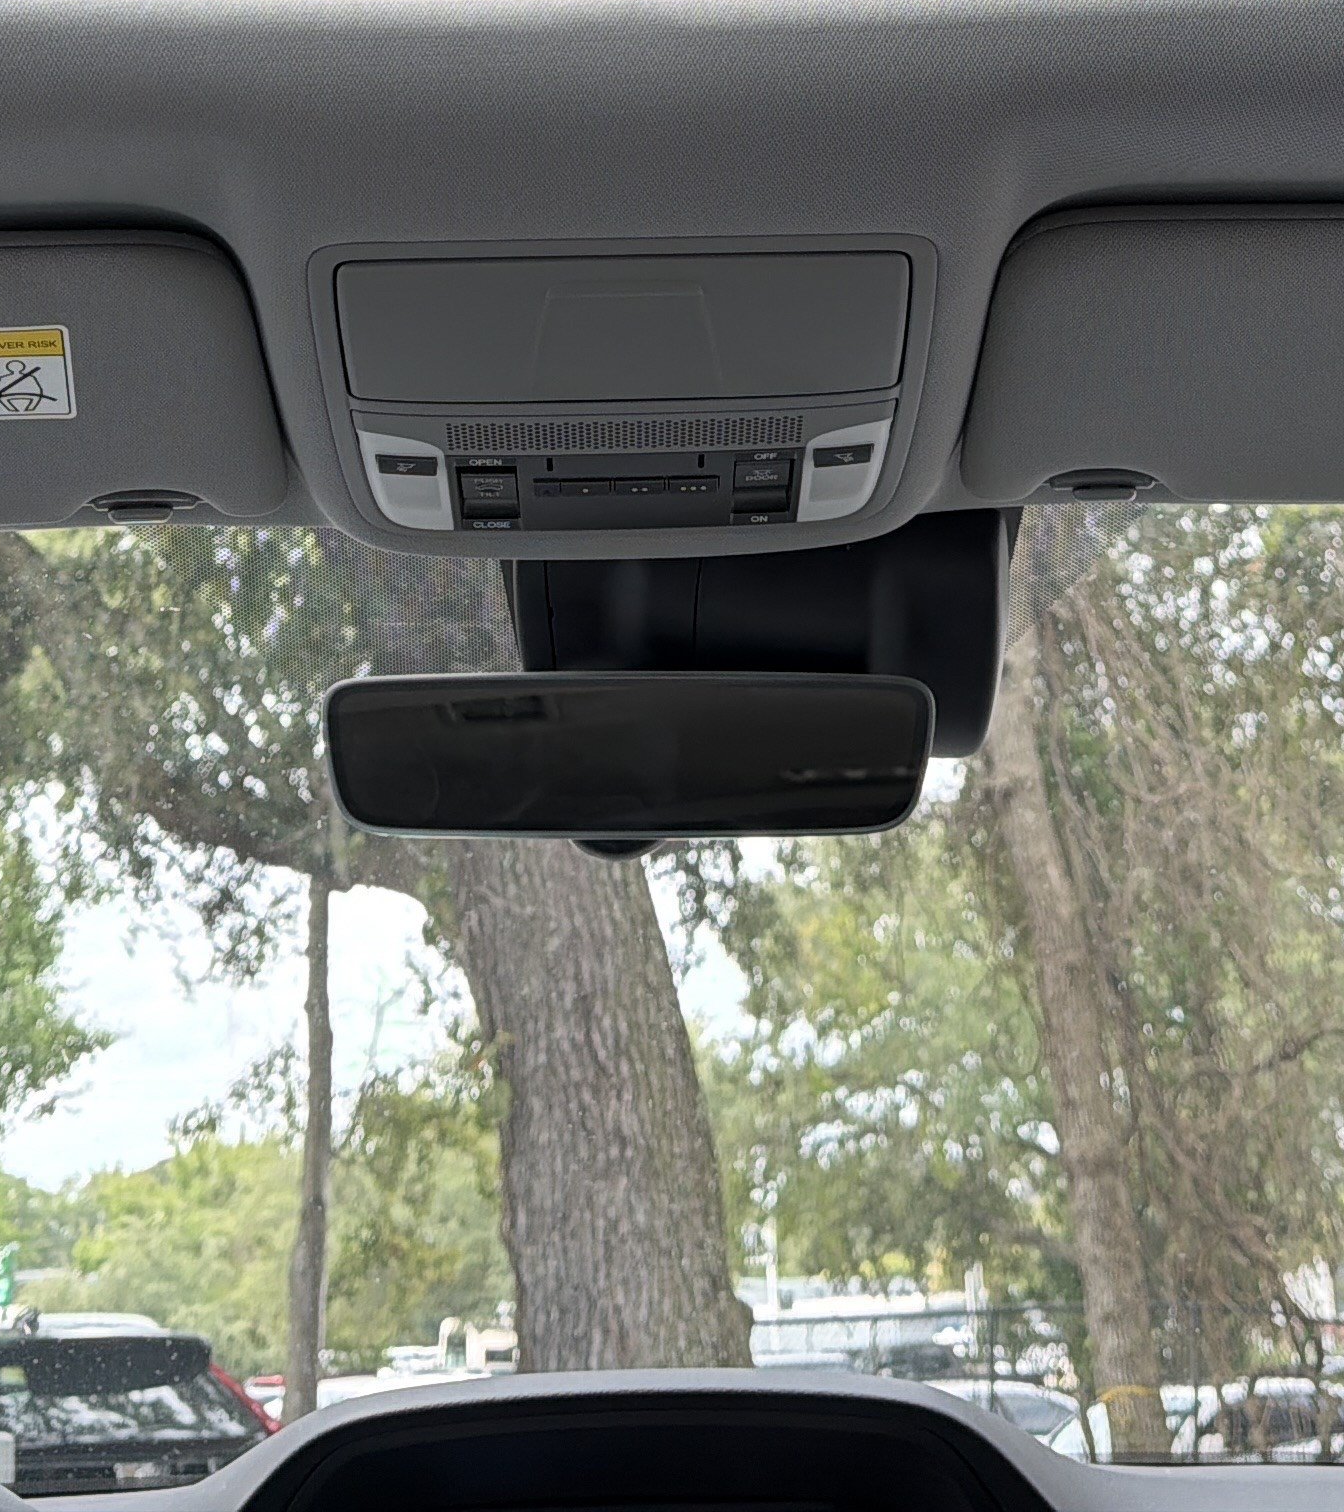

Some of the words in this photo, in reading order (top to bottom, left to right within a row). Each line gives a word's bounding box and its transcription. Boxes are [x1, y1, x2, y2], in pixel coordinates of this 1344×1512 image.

[28, 339, 57, 349] RISK
[753, 452, 778, 461] OFF
[468, 458, 503, 467] OPEN
[750, 515, 769, 524] ON
[472, 520, 512, 529] CLOSE
